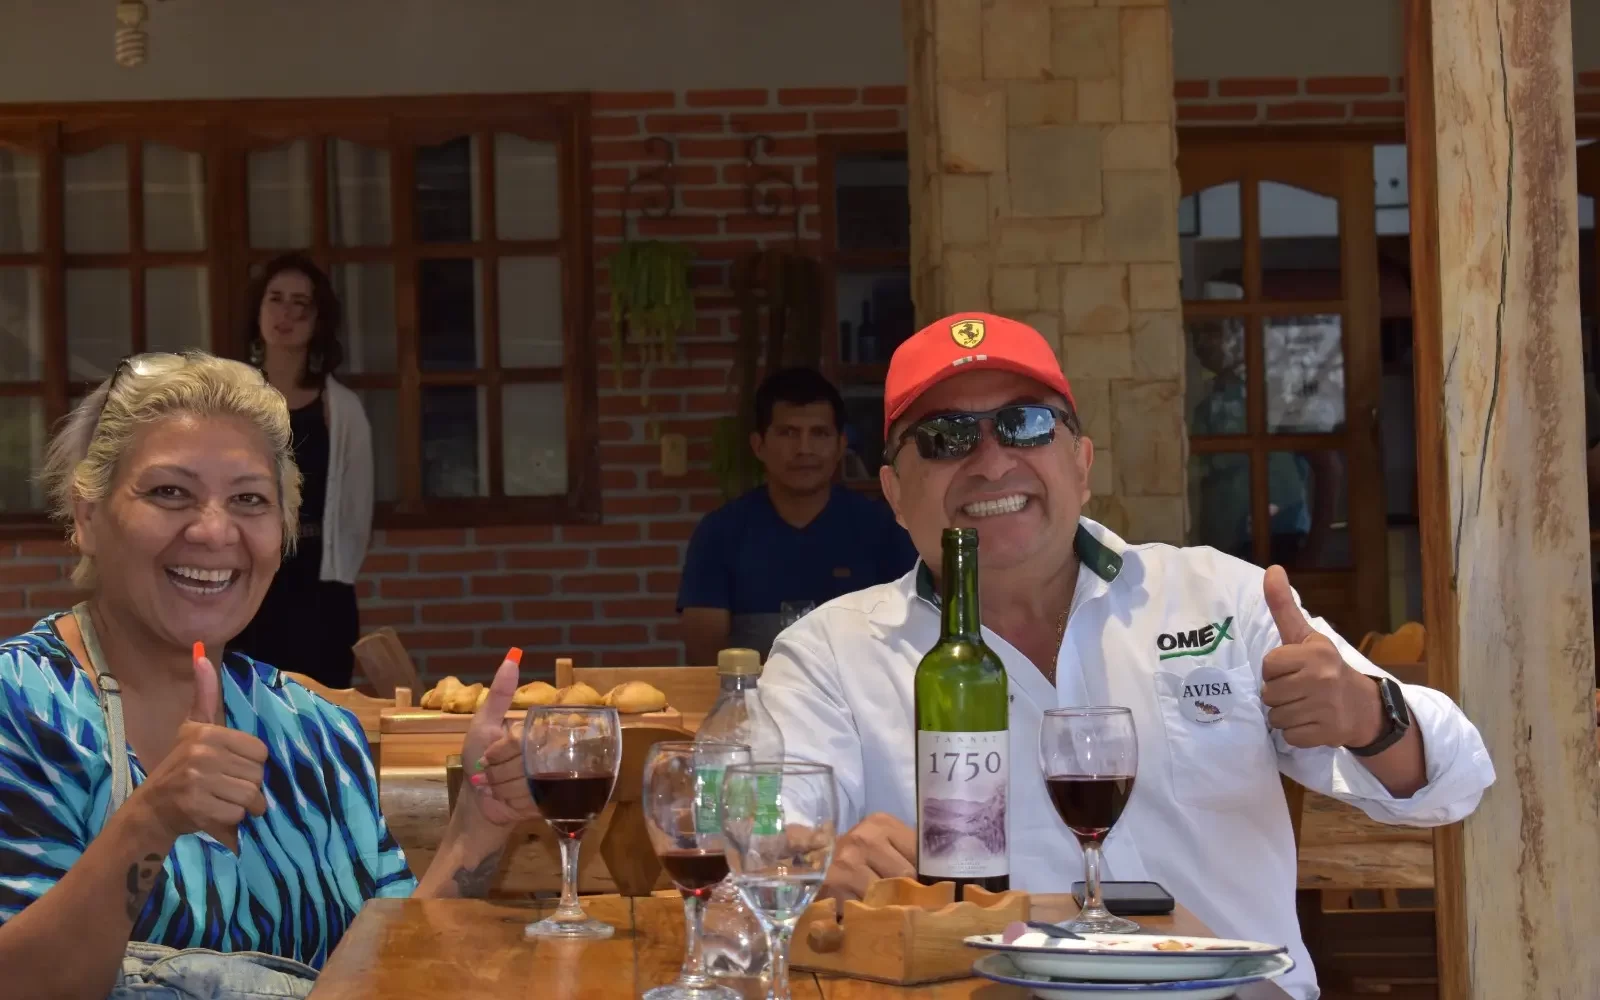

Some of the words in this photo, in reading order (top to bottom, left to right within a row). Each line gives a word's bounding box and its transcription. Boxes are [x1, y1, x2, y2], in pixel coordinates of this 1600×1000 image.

[1157, 616, 1234, 652] OMEX
[1183, 682, 1232, 698] AVISA
[934, 735, 997, 743] TANNAT
[929, 751, 1001, 782] 1750
